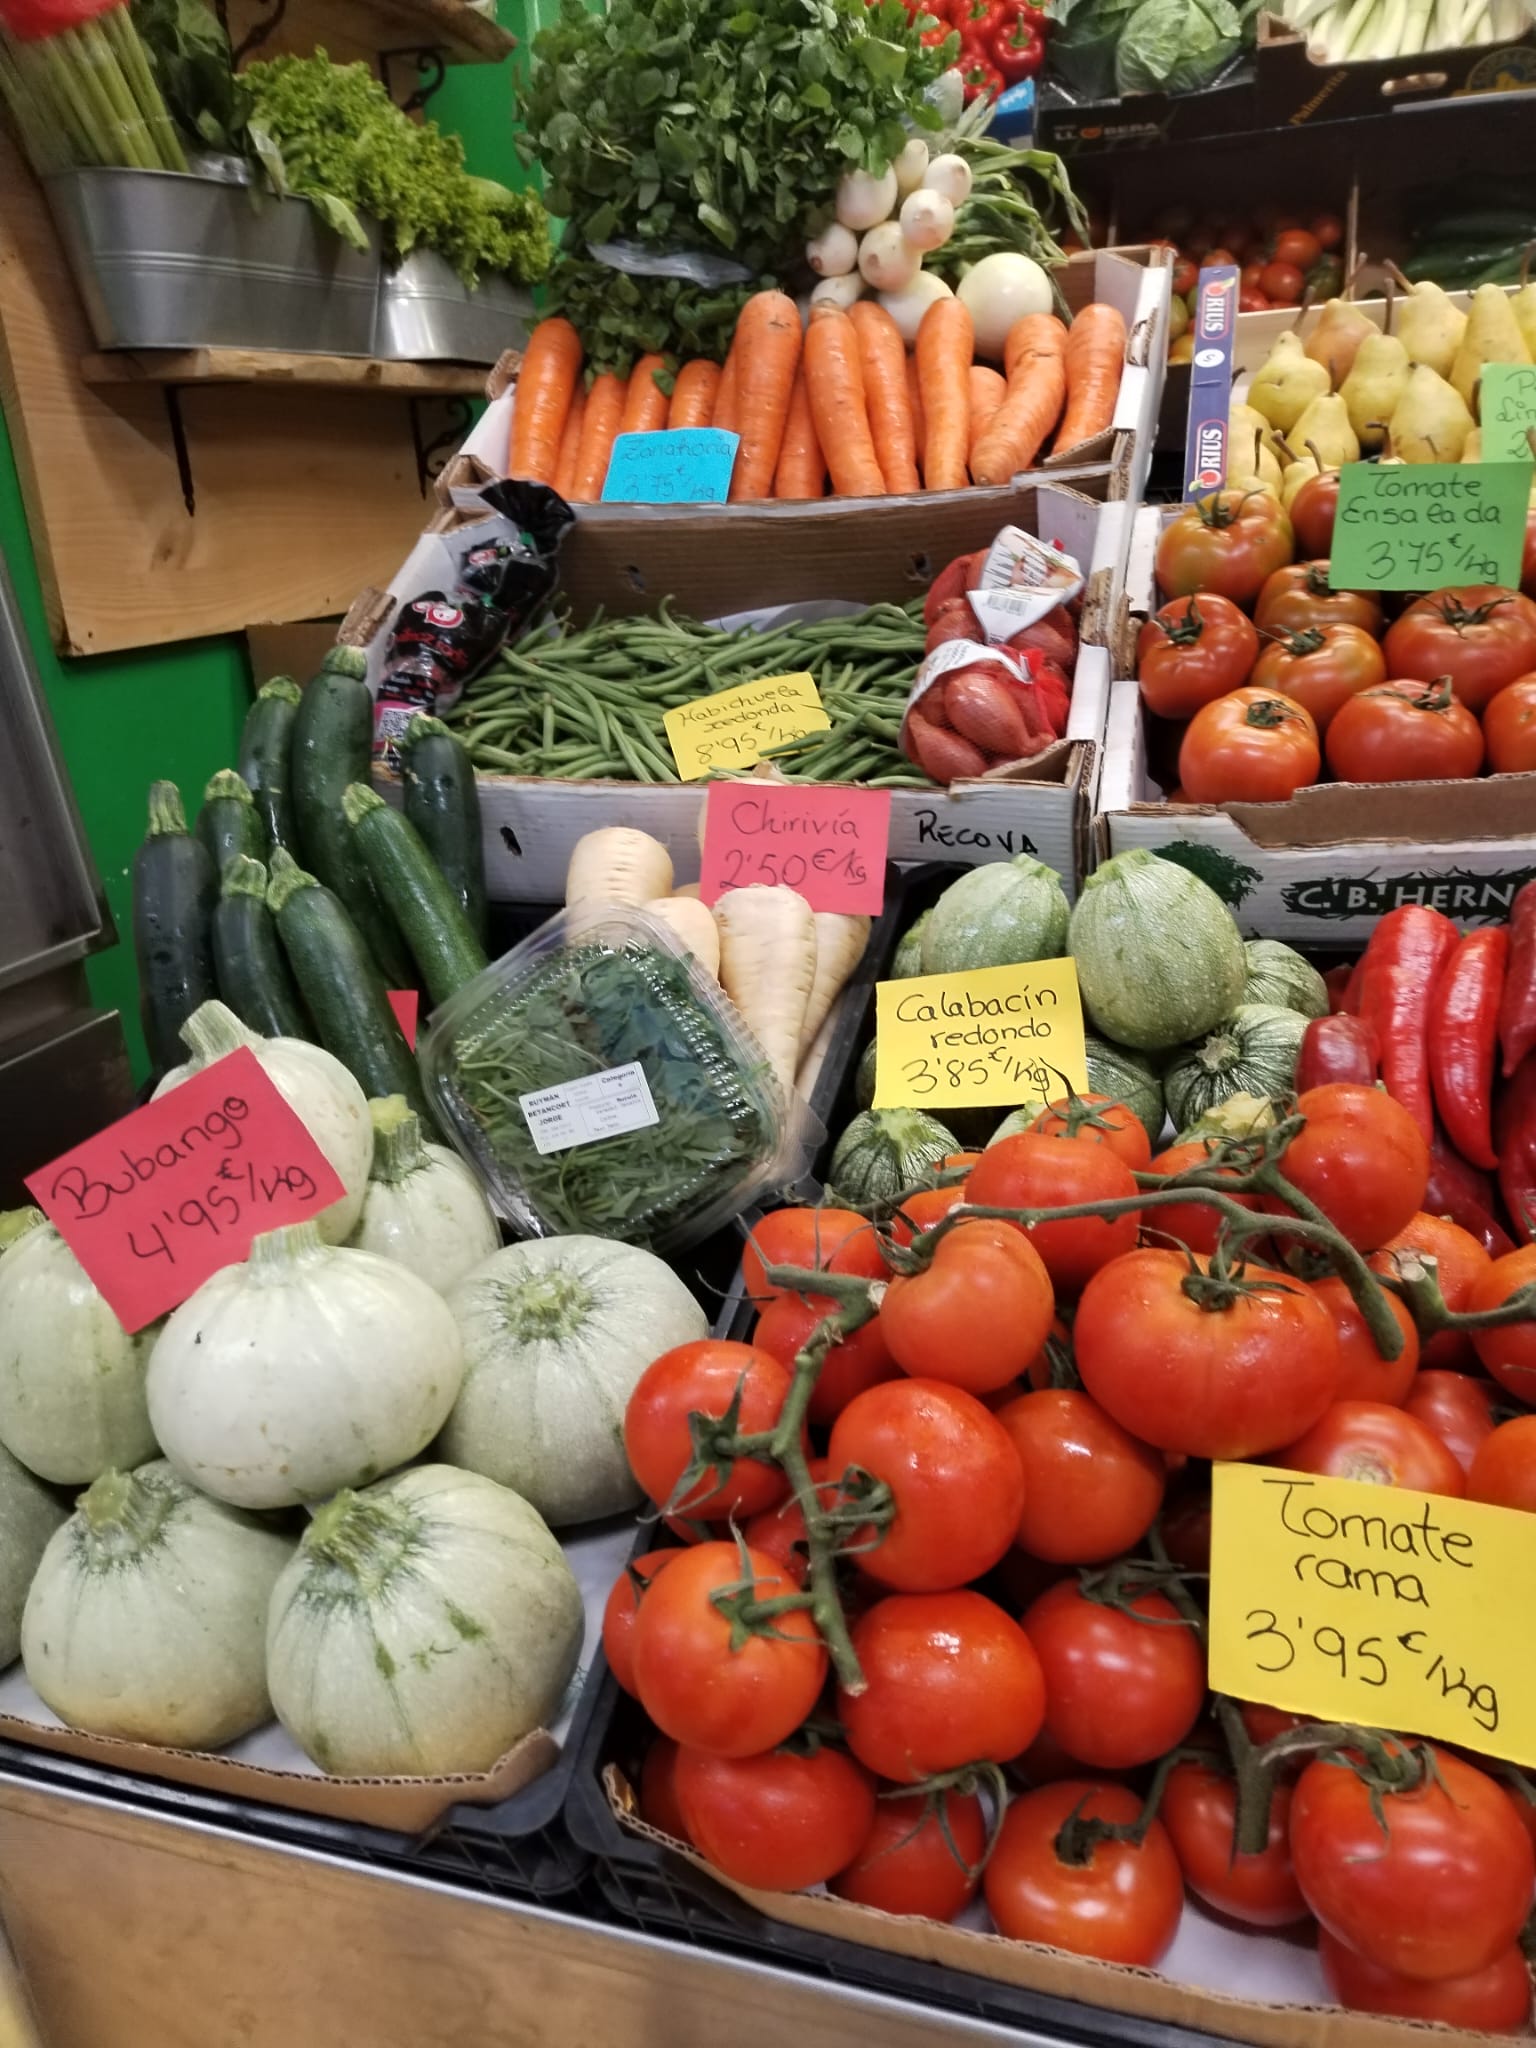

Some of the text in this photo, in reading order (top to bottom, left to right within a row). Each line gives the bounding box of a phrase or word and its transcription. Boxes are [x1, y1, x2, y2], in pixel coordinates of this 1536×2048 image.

[1367, 470, 1482, 499] Tomate
[678, 684, 804, 728] Habichuela
[703, 702, 795, 733] redonda
[731, 800, 860, 839] Chirivía
[1393, 883, 1516, 909] HERN
[896, 984, 1058, 1023] Calabacín
[930, 1017, 1052, 1049] redondo
[51, 1096, 249, 1220] Bubango
[1262, 1478, 1474, 1568] Tomate
[1294, 1554, 1430, 1608] rama
